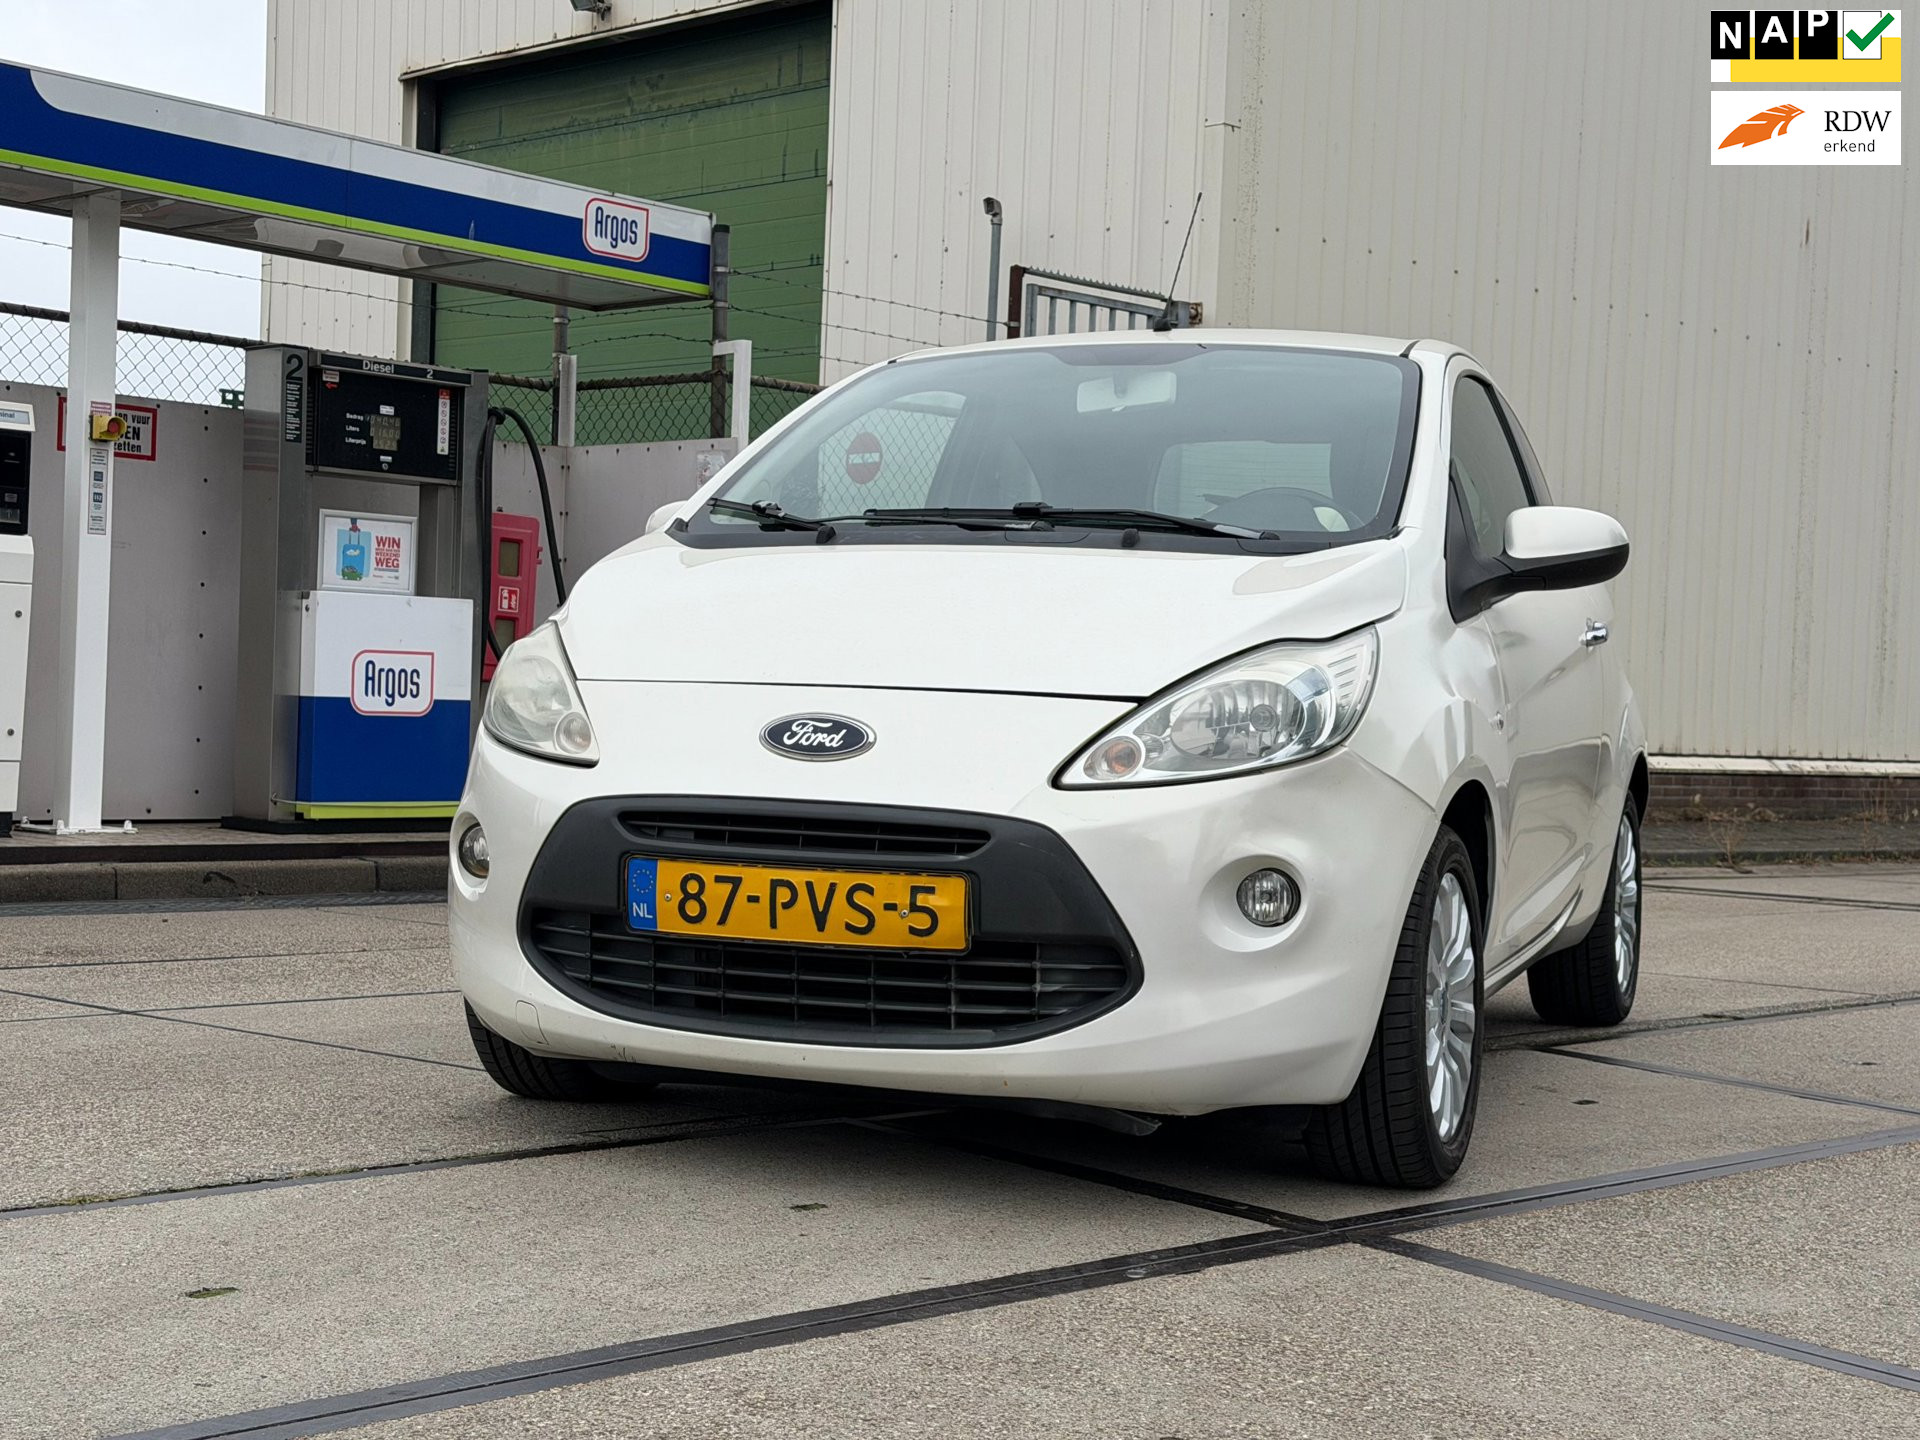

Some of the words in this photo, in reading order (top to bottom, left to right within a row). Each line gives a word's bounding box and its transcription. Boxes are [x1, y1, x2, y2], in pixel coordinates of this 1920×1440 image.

[594, 205, 639, 249] Argos
[286, 353, 304, 381] 2
[362, 360, 395, 374] Diesel
[426, 368, 434, 379] 2
[131, 414, 151, 425] vuur
[375, 535, 401, 549] WIN
[374, 557, 400, 569] WEG
[364, 659, 421, 707] Argos
[783, 719, 848, 748] Ford
[632, 901, 653, 919] NL
[676, 872, 940, 938] 87-PVS-5
